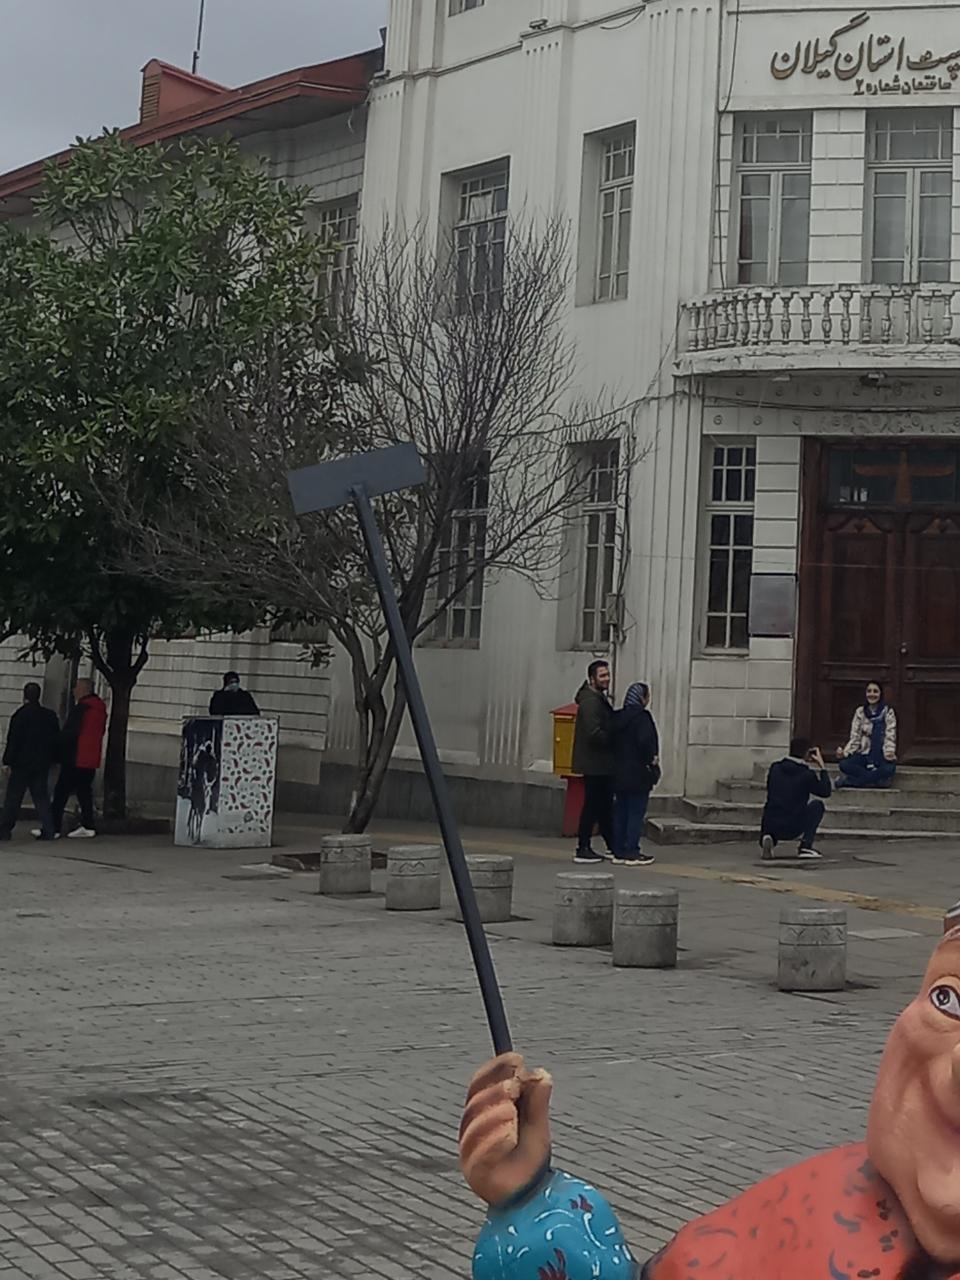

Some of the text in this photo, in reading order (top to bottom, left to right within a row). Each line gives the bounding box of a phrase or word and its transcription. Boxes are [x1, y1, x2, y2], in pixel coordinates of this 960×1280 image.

[769, 11, 870, 80] گیلان
[834, 32, 905, 81] استان
[866, 74, 900, 95] شماره
[901, 74, 952, 95] ساختمان
